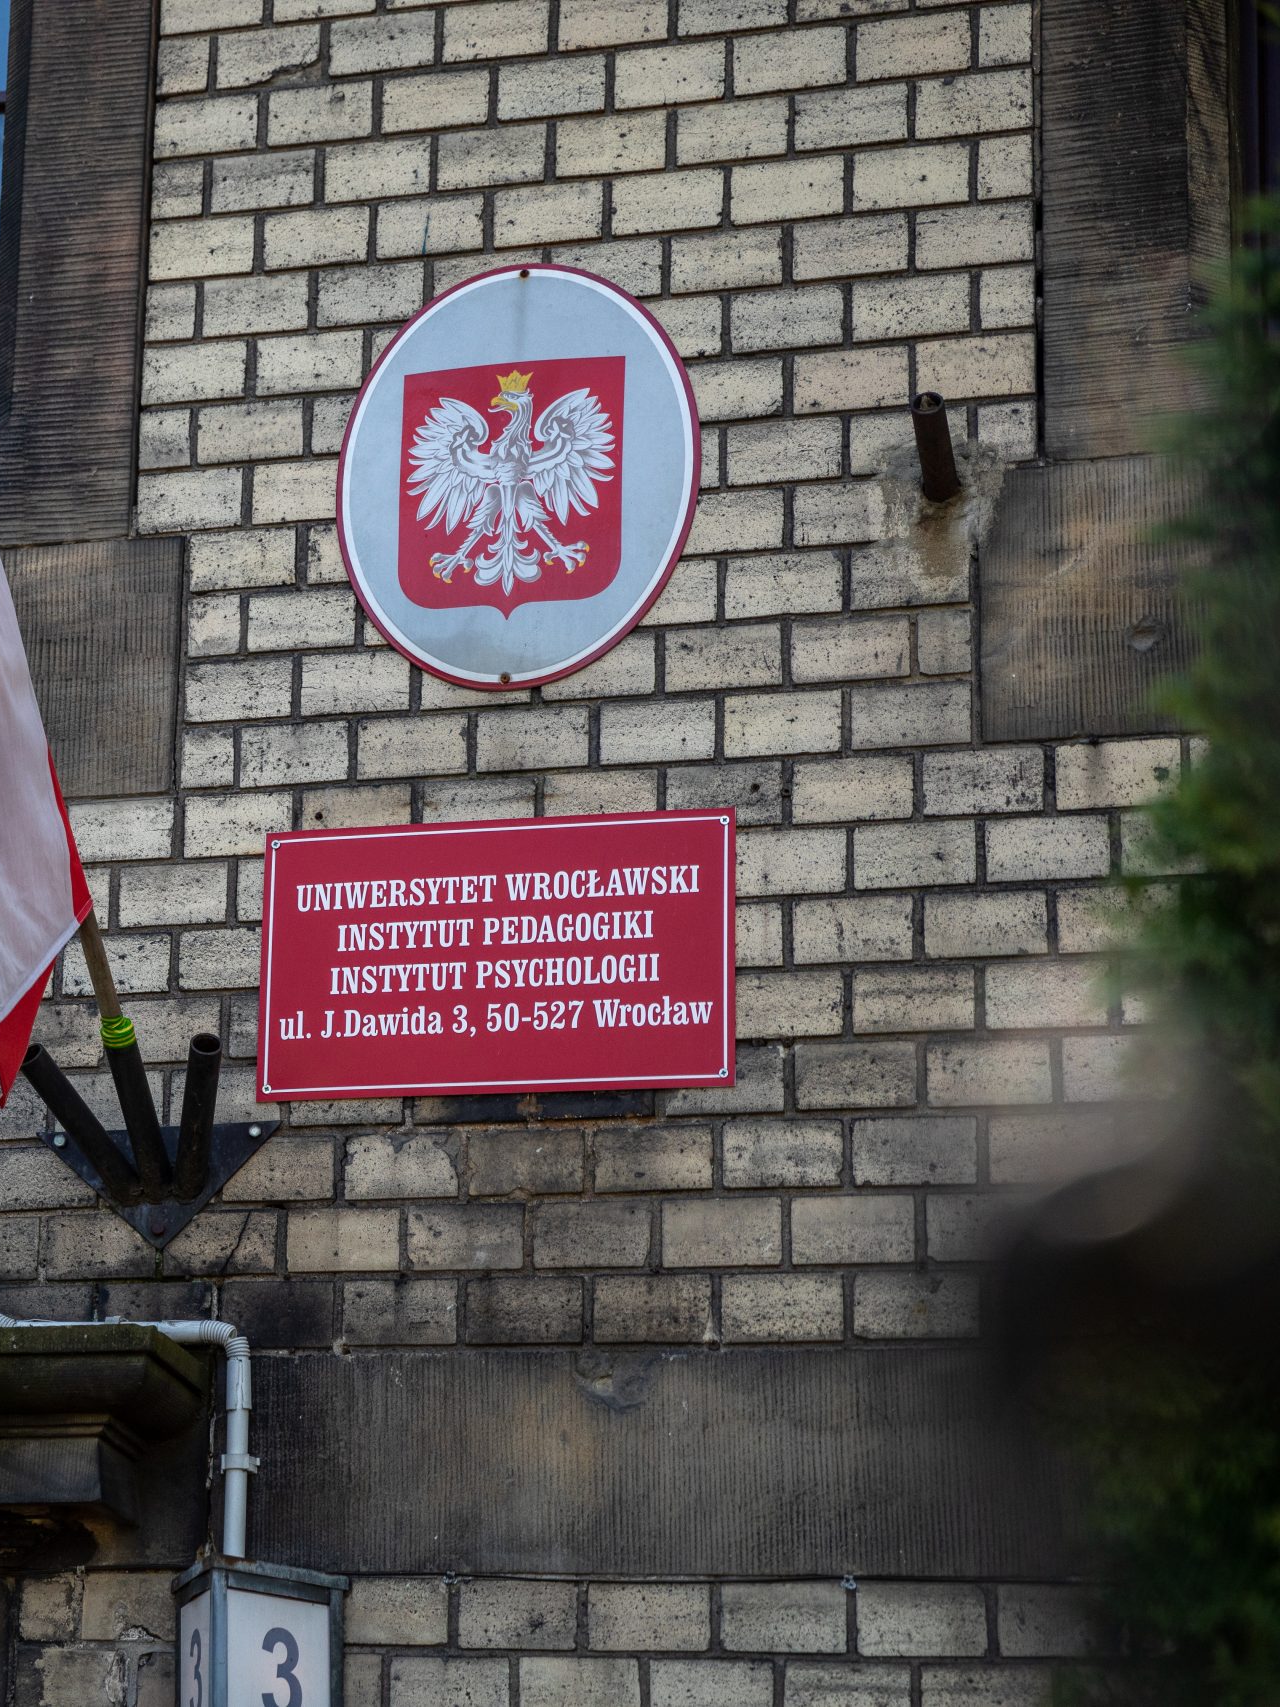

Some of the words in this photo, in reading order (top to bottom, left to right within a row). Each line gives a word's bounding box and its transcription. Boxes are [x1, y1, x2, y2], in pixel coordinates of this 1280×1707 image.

[296, 872, 497, 913] UNIWERSYTET
[505, 864, 700, 902] WROCŁAWSKI
[337, 918, 474, 952] INSTYTUT
[482, 909, 654, 946] PEDAGOGIKI
[330, 961, 467, 995] INSTYTUT
[476, 953, 660, 990] PSYCHOLOGII
[279, 1010, 312, 1040] ul.
[320, 1006, 444, 1039] J.Dawida
[452, 1004, 477, 1038] 3,
[486, 1000, 585, 1033] 50-527
[592, 995, 714, 1028] Wrocław
[261, 1626, 303, 1707] 3
